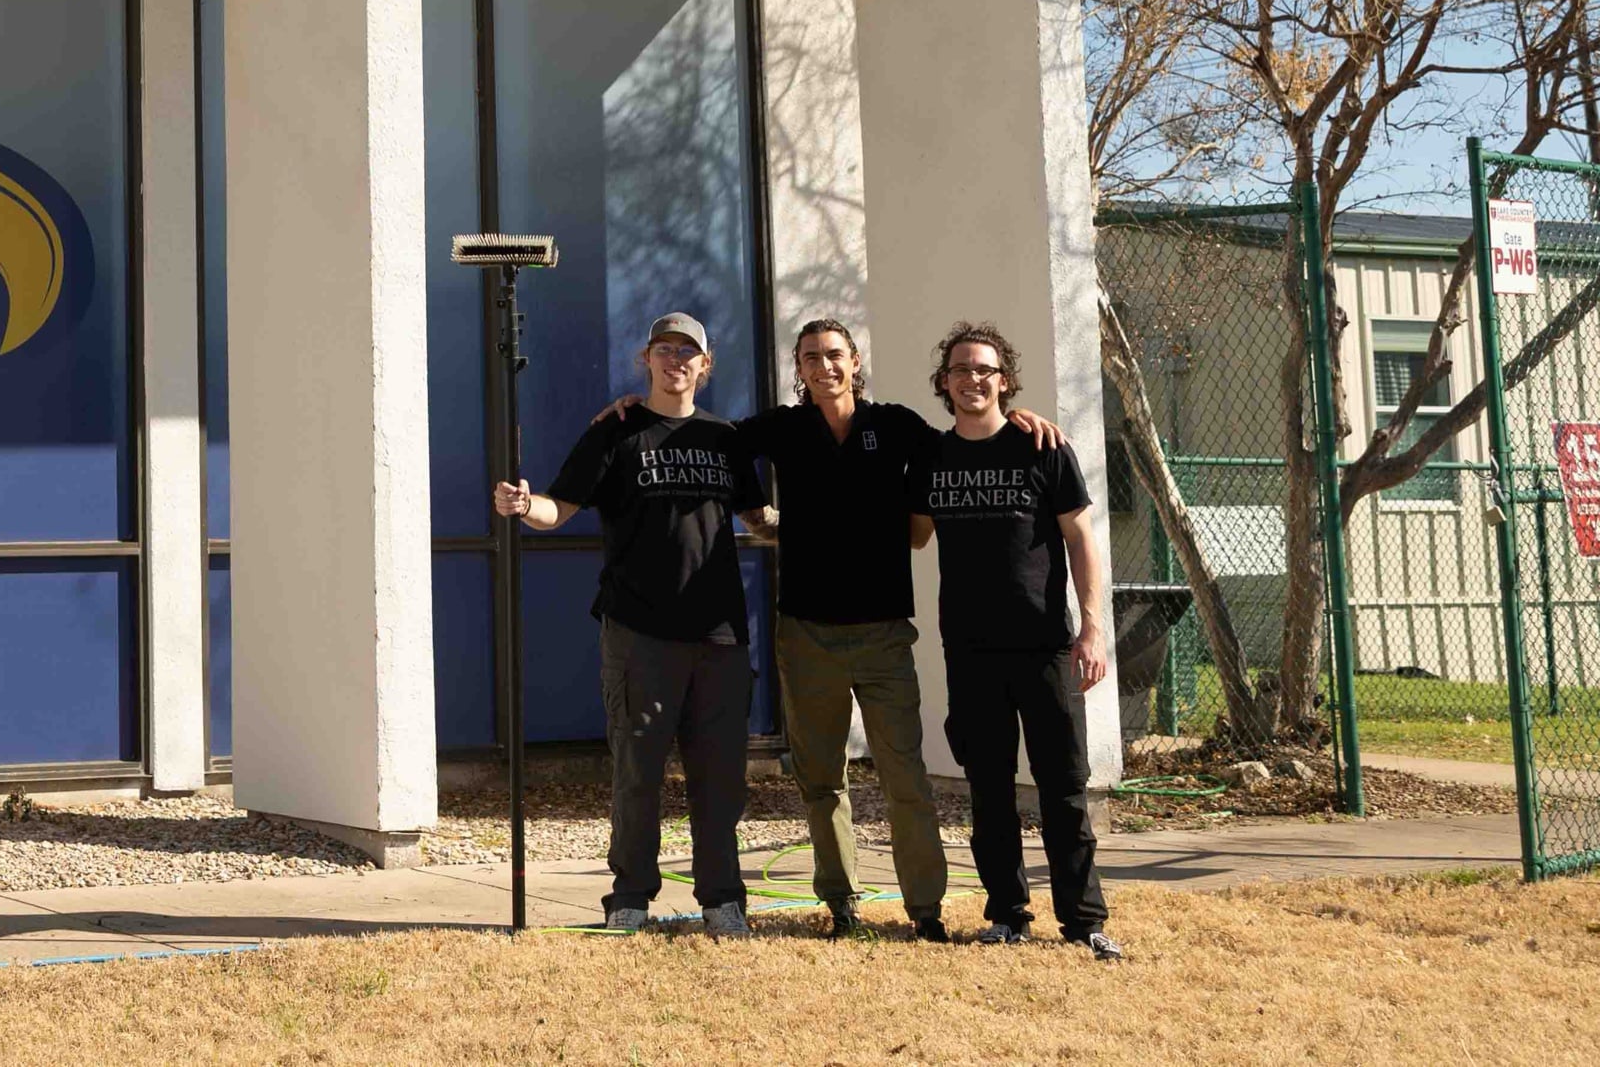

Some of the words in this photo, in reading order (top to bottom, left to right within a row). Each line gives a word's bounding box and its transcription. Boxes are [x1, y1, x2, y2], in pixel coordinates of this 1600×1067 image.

[1504, 232, 1522, 245] Gate
[1494, 247, 1534, 276] P-W6
[640, 448, 729, 469] HUMBLE
[932, 469, 1025, 488] HUMBLE
[928, 489, 1032, 508] CLEANERS
